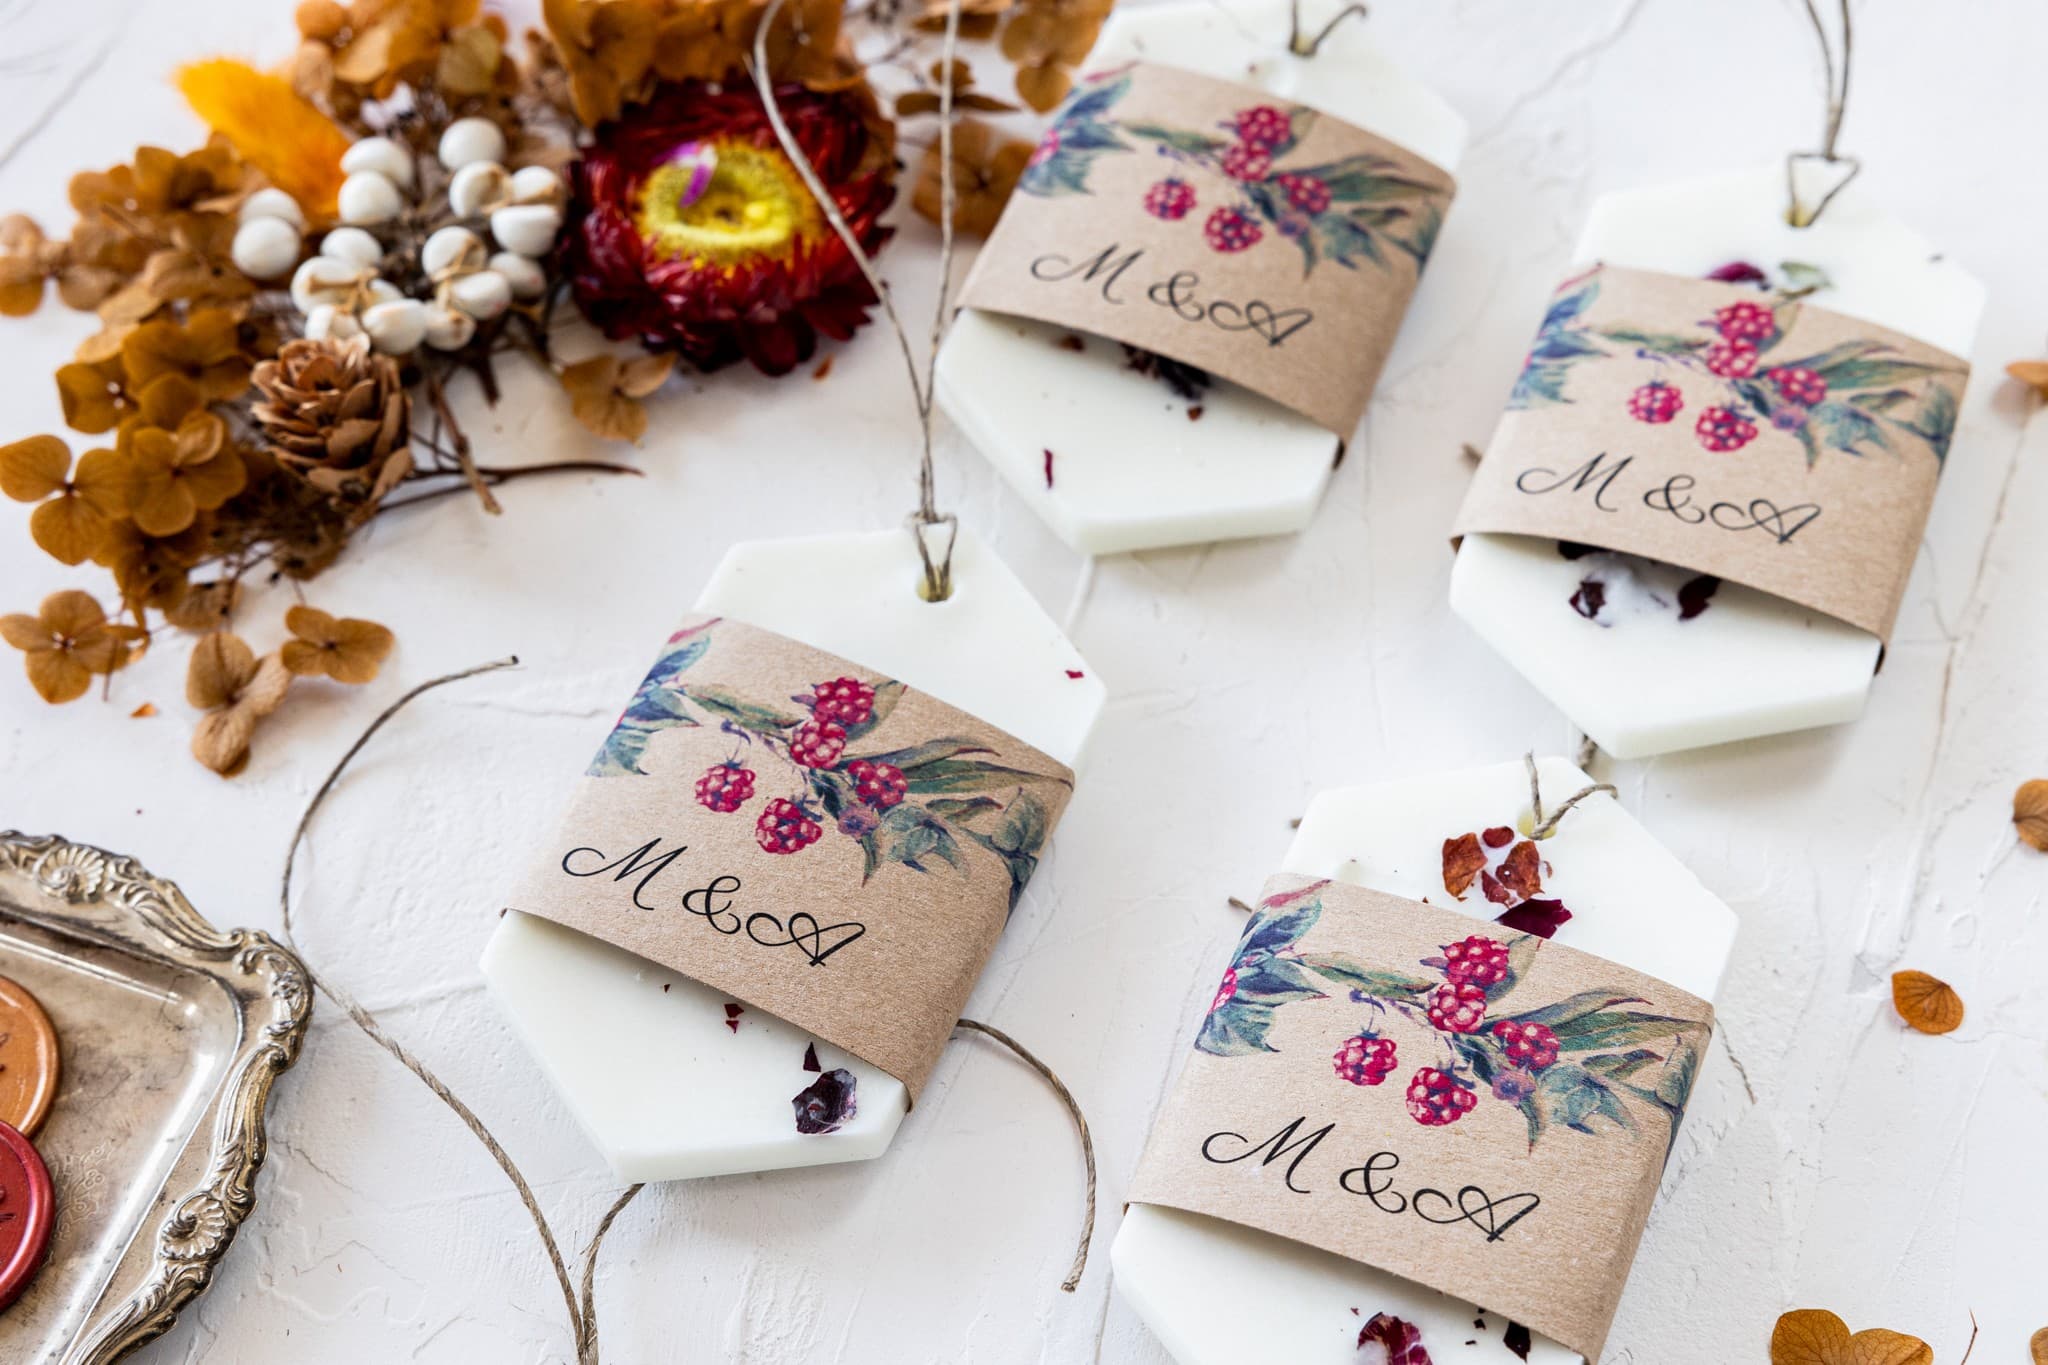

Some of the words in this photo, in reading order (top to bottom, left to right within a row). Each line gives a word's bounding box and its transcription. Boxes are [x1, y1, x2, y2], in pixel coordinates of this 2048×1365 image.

[1030, 242, 1145, 305] M
[1515, 451, 1633, 513] M
[562, 837, 688, 911] M
[1202, 1116, 1336, 1194] M
